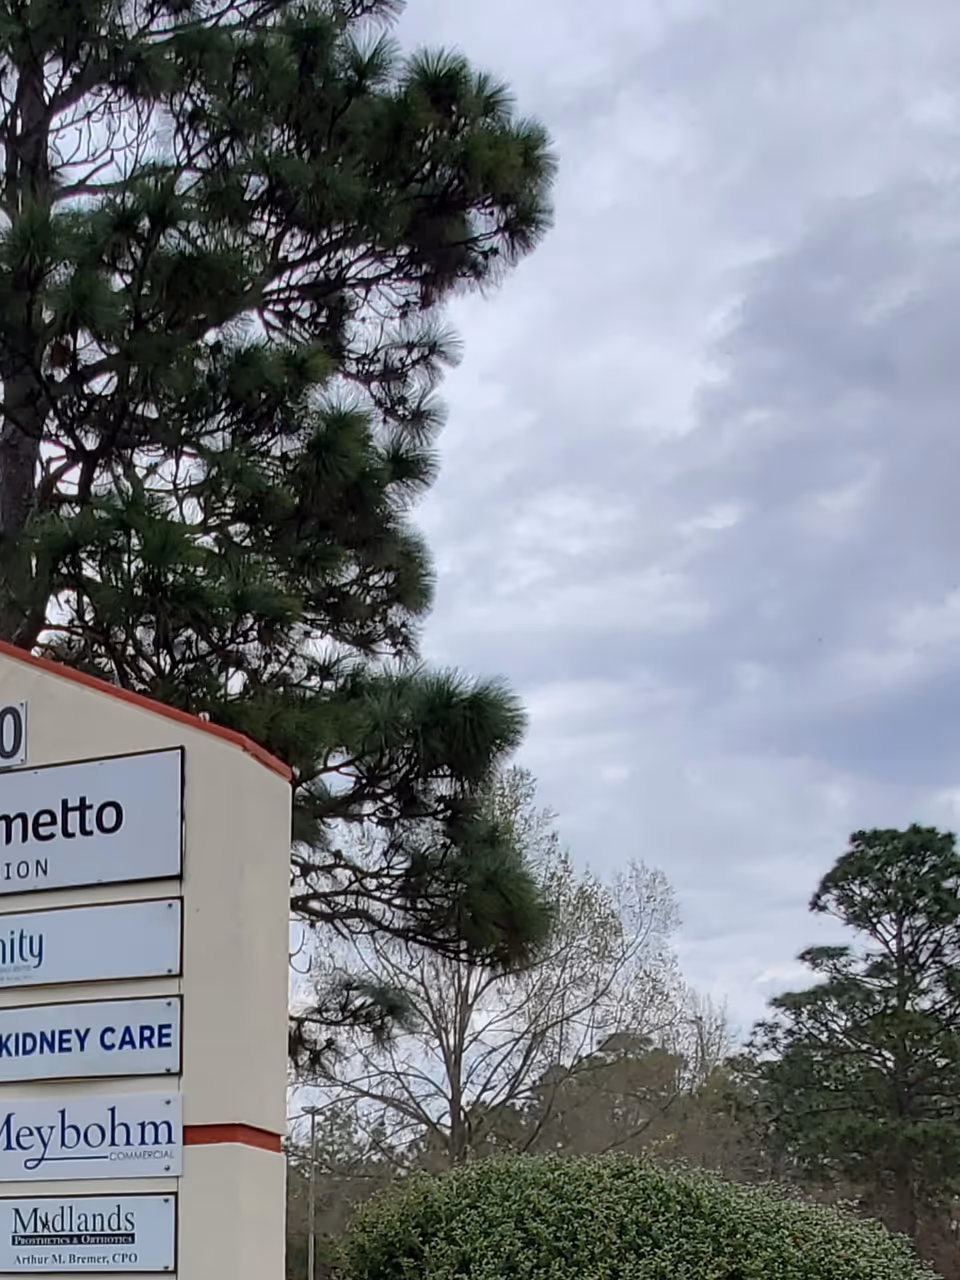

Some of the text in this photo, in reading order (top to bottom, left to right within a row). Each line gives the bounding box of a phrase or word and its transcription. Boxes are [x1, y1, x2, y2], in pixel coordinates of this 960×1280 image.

[98, 1023, 173, 1051] CARE
[109, 1150, 174, 1161] COMMERCIAL
[72, 1236, 78, 1244] &
[14, 1253, 138, 1265] Arthur M. Bremer, CPO
